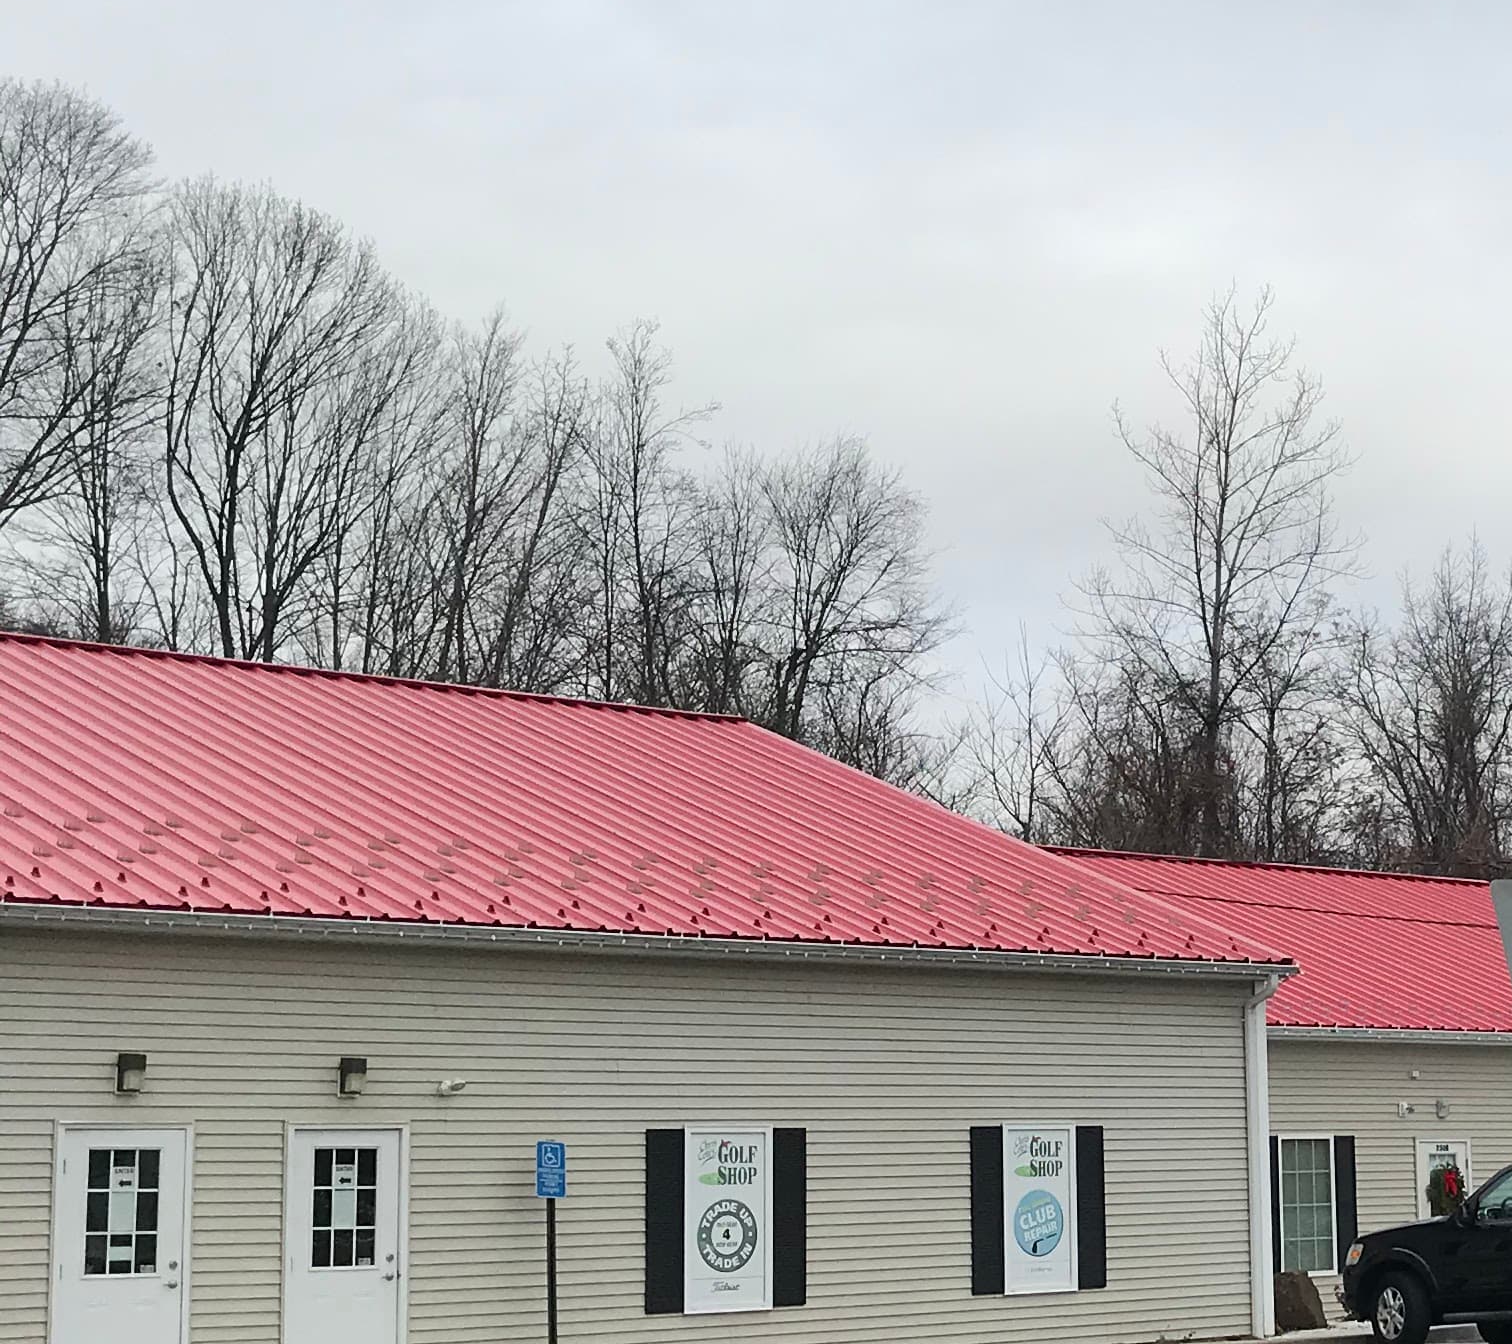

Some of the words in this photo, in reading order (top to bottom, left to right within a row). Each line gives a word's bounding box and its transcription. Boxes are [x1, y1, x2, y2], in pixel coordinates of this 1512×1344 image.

[717, 1142, 758, 1165] GOLF
[1029, 1140, 1063, 1158] GOLF
[717, 1165, 758, 1186] SHOP
[1029, 1158, 1063, 1178] SHOP
[700, 1201, 739, 1229] TRADE
[739, 1207, 754, 1228] UP
[1019, 1203, 1057, 1230] CLUB
[1023, 1220, 1058, 1242] REPAIR
[702, 1243, 741, 1269] TRADE
[740, 1242, 754, 1260] IN
